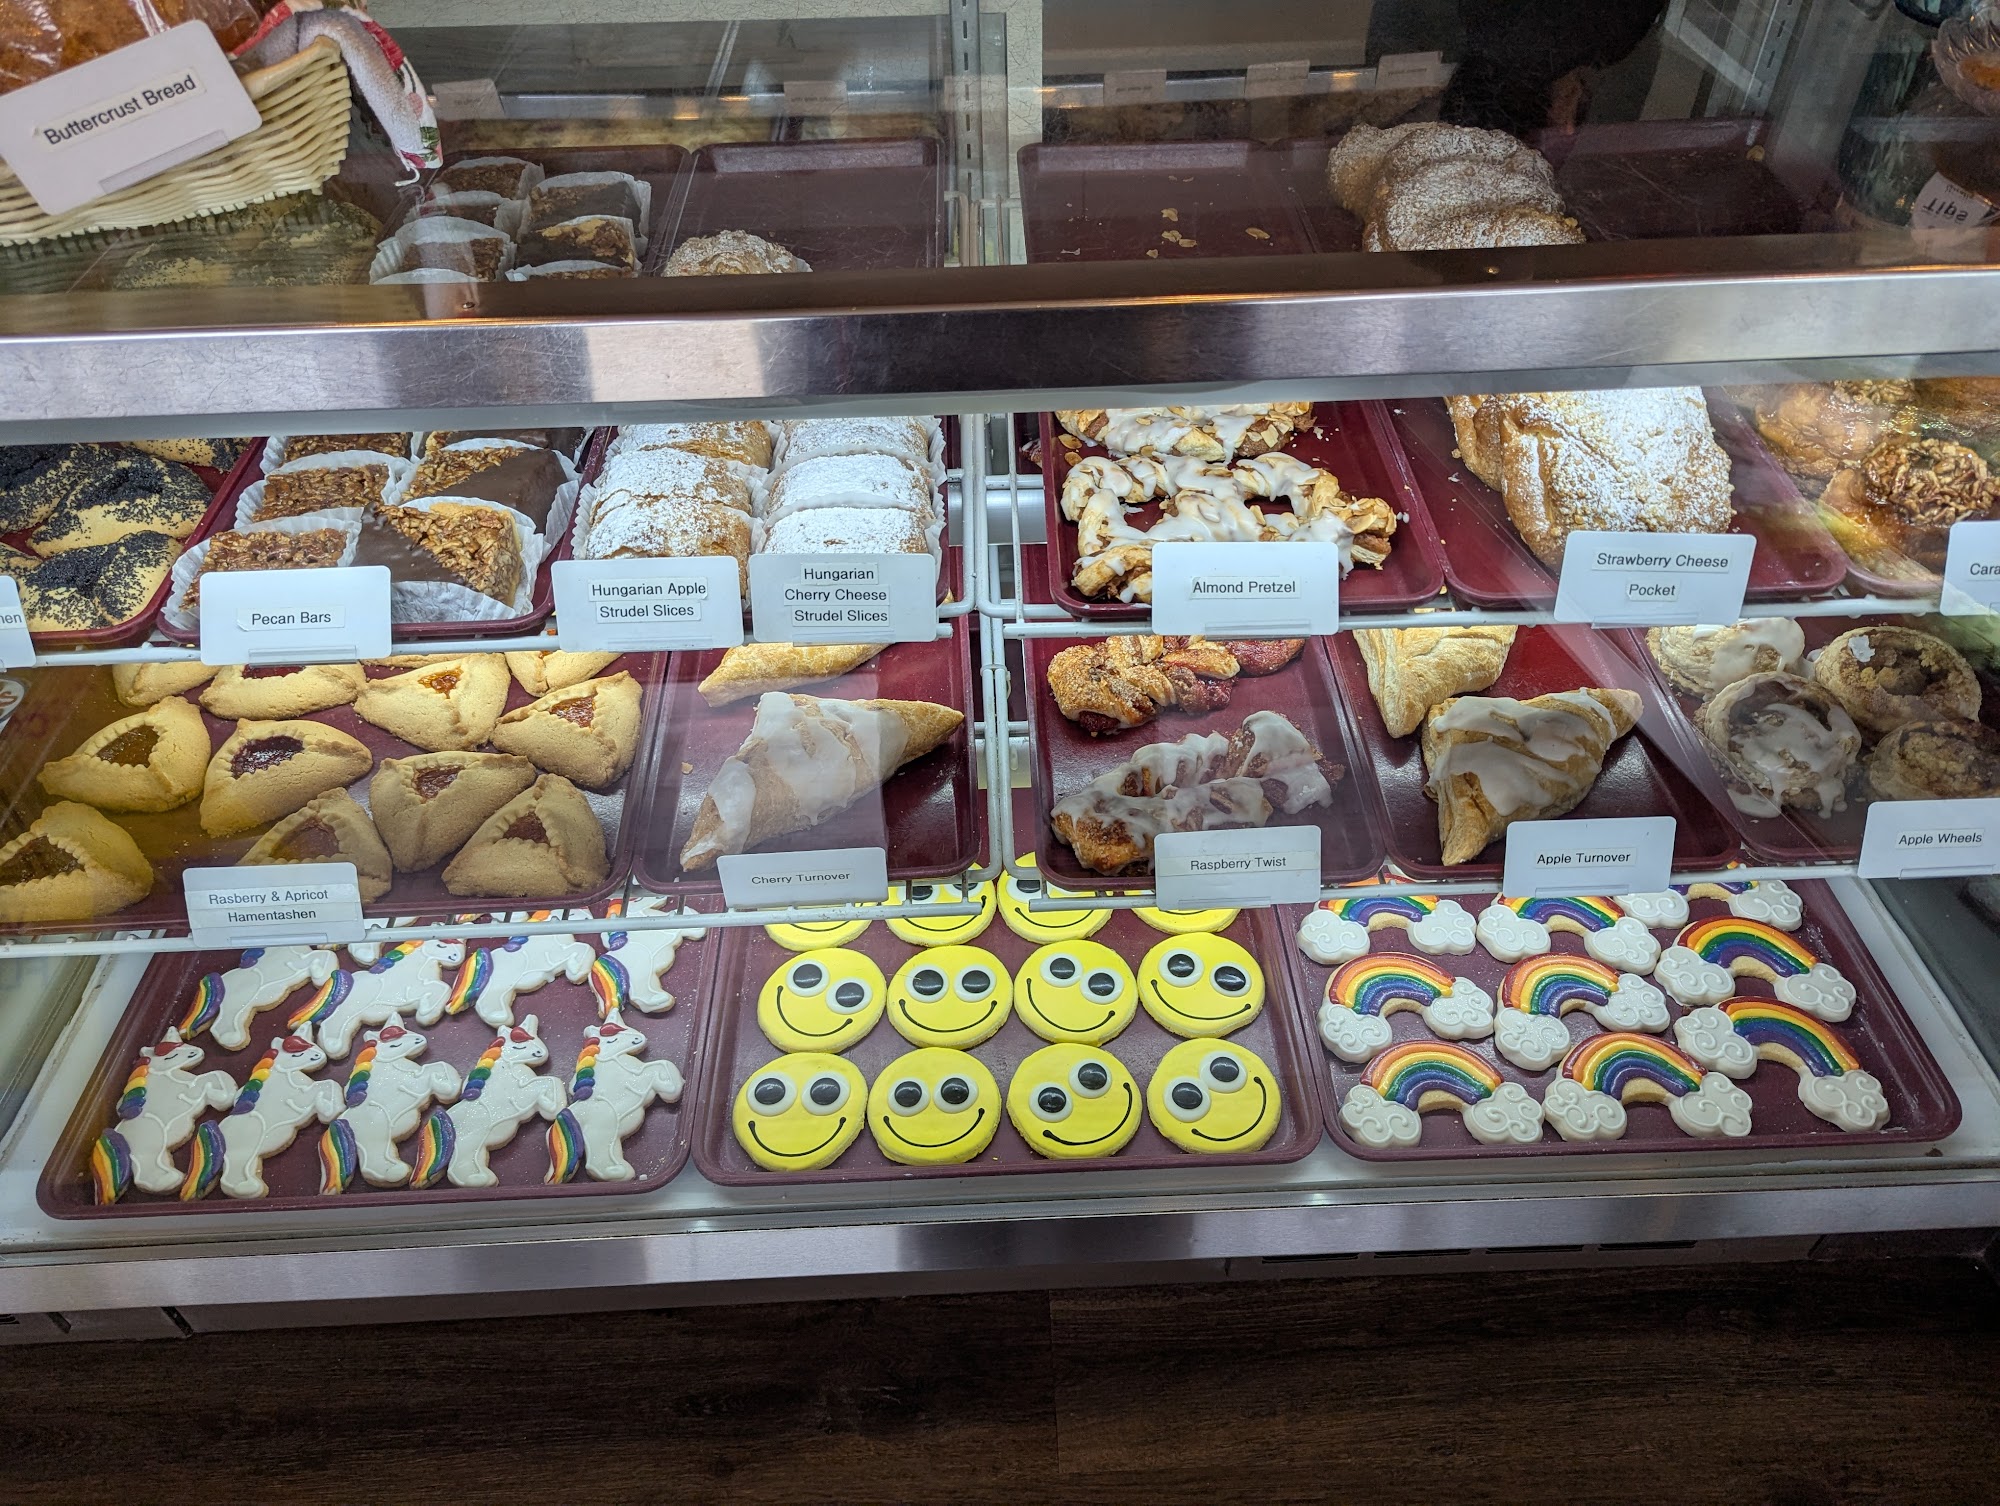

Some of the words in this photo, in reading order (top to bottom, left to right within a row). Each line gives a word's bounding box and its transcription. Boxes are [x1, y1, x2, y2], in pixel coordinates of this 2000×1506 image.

[43, 97, 143, 145] Buttercrust
[142, 74, 197, 106] Bread
[1597, 552, 1672, 568] Strawberry
[1675, 554, 1729, 568] Cheese
[804, 568, 874, 581] Hungarian
[592, 583, 663, 597] Hungarian
[667, 582, 706, 596] Apple
[1193, 581, 1243, 593] Almond
[1248, 580, 1296, 593] Pretzel
[1628, 584, 1676, 596] Pocket
[784, 588, 830, 602] Cherry
[835, 588, 887, 600] Cheese
[252, 613, 295, 625] Pecan
[300, 611, 332, 624] Bars
[600, 605, 649, 618] Strudel
[653, 604, 694, 617] Slices
[794, 609, 842, 621] Strudel
[847, 609, 888, 621] Slices
[1899, 834, 1933, 846] Apple
[1938, 832, 1983, 844] Wheels
[1190, 859, 1251, 871] Raspberry
[1254, 857, 1287, 867] Twist
[1537, 853, 1572, 865] Apple
[1576, 852, 1631, 863] Turnover
[751, 876, 792, 885] Cherry
[796, 873, 850, 882] Turnover
[208, 893, 267, 904] Rasberry
[271, 890, 280, 902] &
[285, 889, 329, 902] Apricot
[228, 909, 316, 922] Hamentashen
